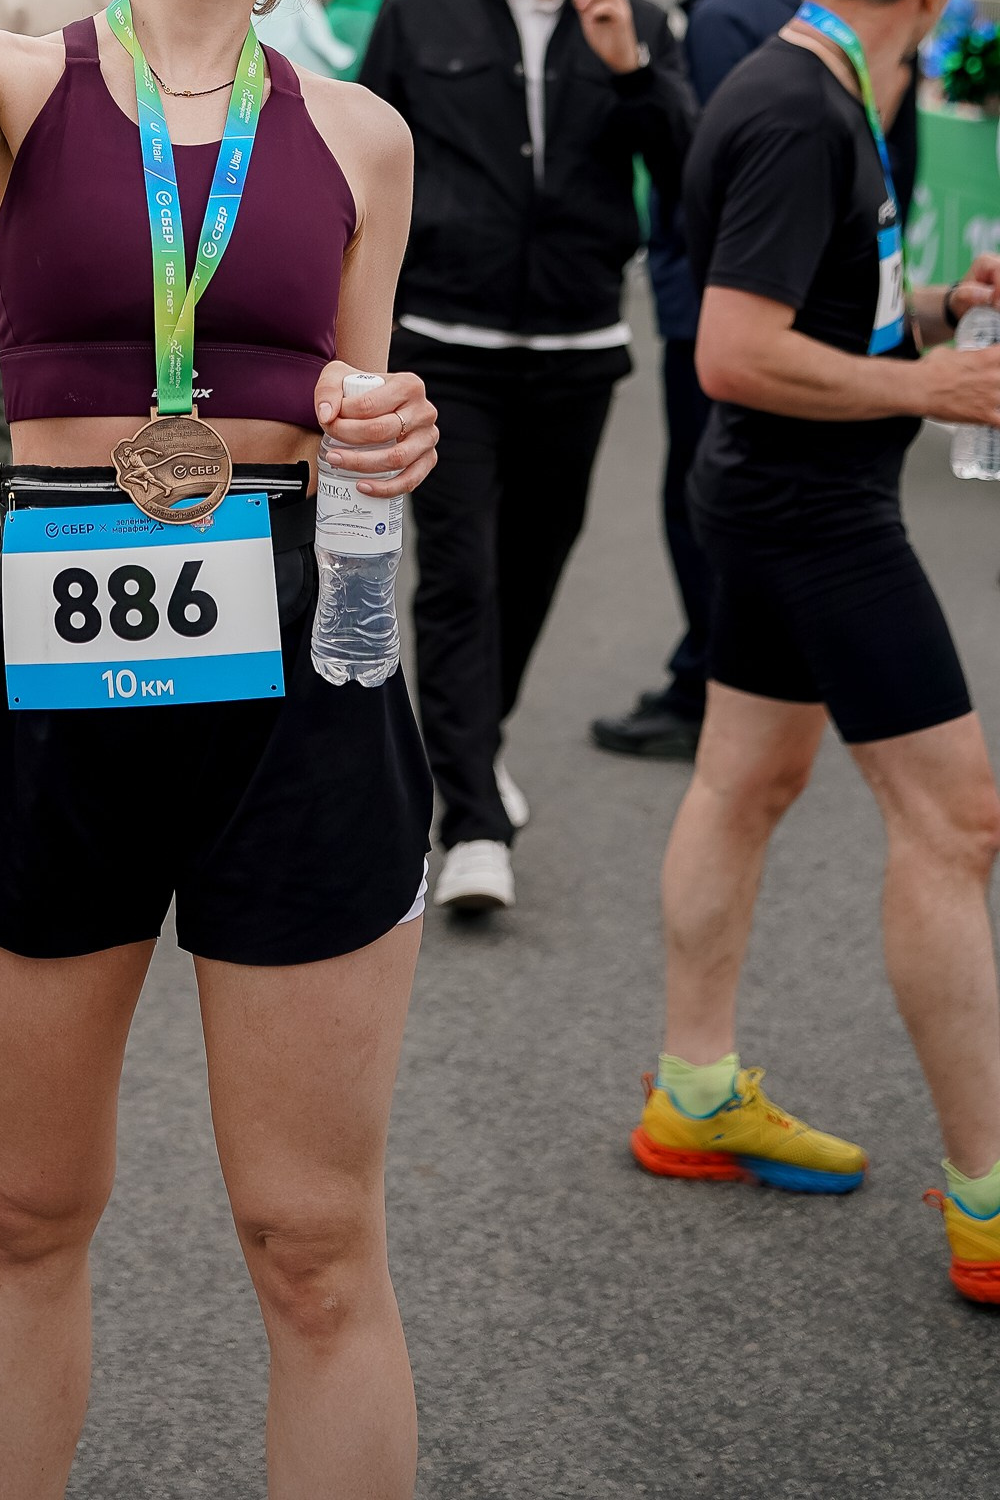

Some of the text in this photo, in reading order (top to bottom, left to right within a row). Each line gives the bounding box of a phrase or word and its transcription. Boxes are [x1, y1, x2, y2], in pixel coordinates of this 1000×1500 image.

[124, 24, 134, 39] ле
[247, 60, 257, 78] 185
[151, 138, 164, 163] Utair
[229, 148, 243, 170] Utair
[161, 208, 174, 244] СБЕР
[212, 206, 229, 241] СБЕР
[165, 260, 175, 286] 185
[189, 465, 220, 476] СБЕР
[62, 523, 95, 535] СБЕР
[112, 525, 150, 534] марафон
[52, 560, 218, 644] 886
[102, 669, 138, 699] 10
